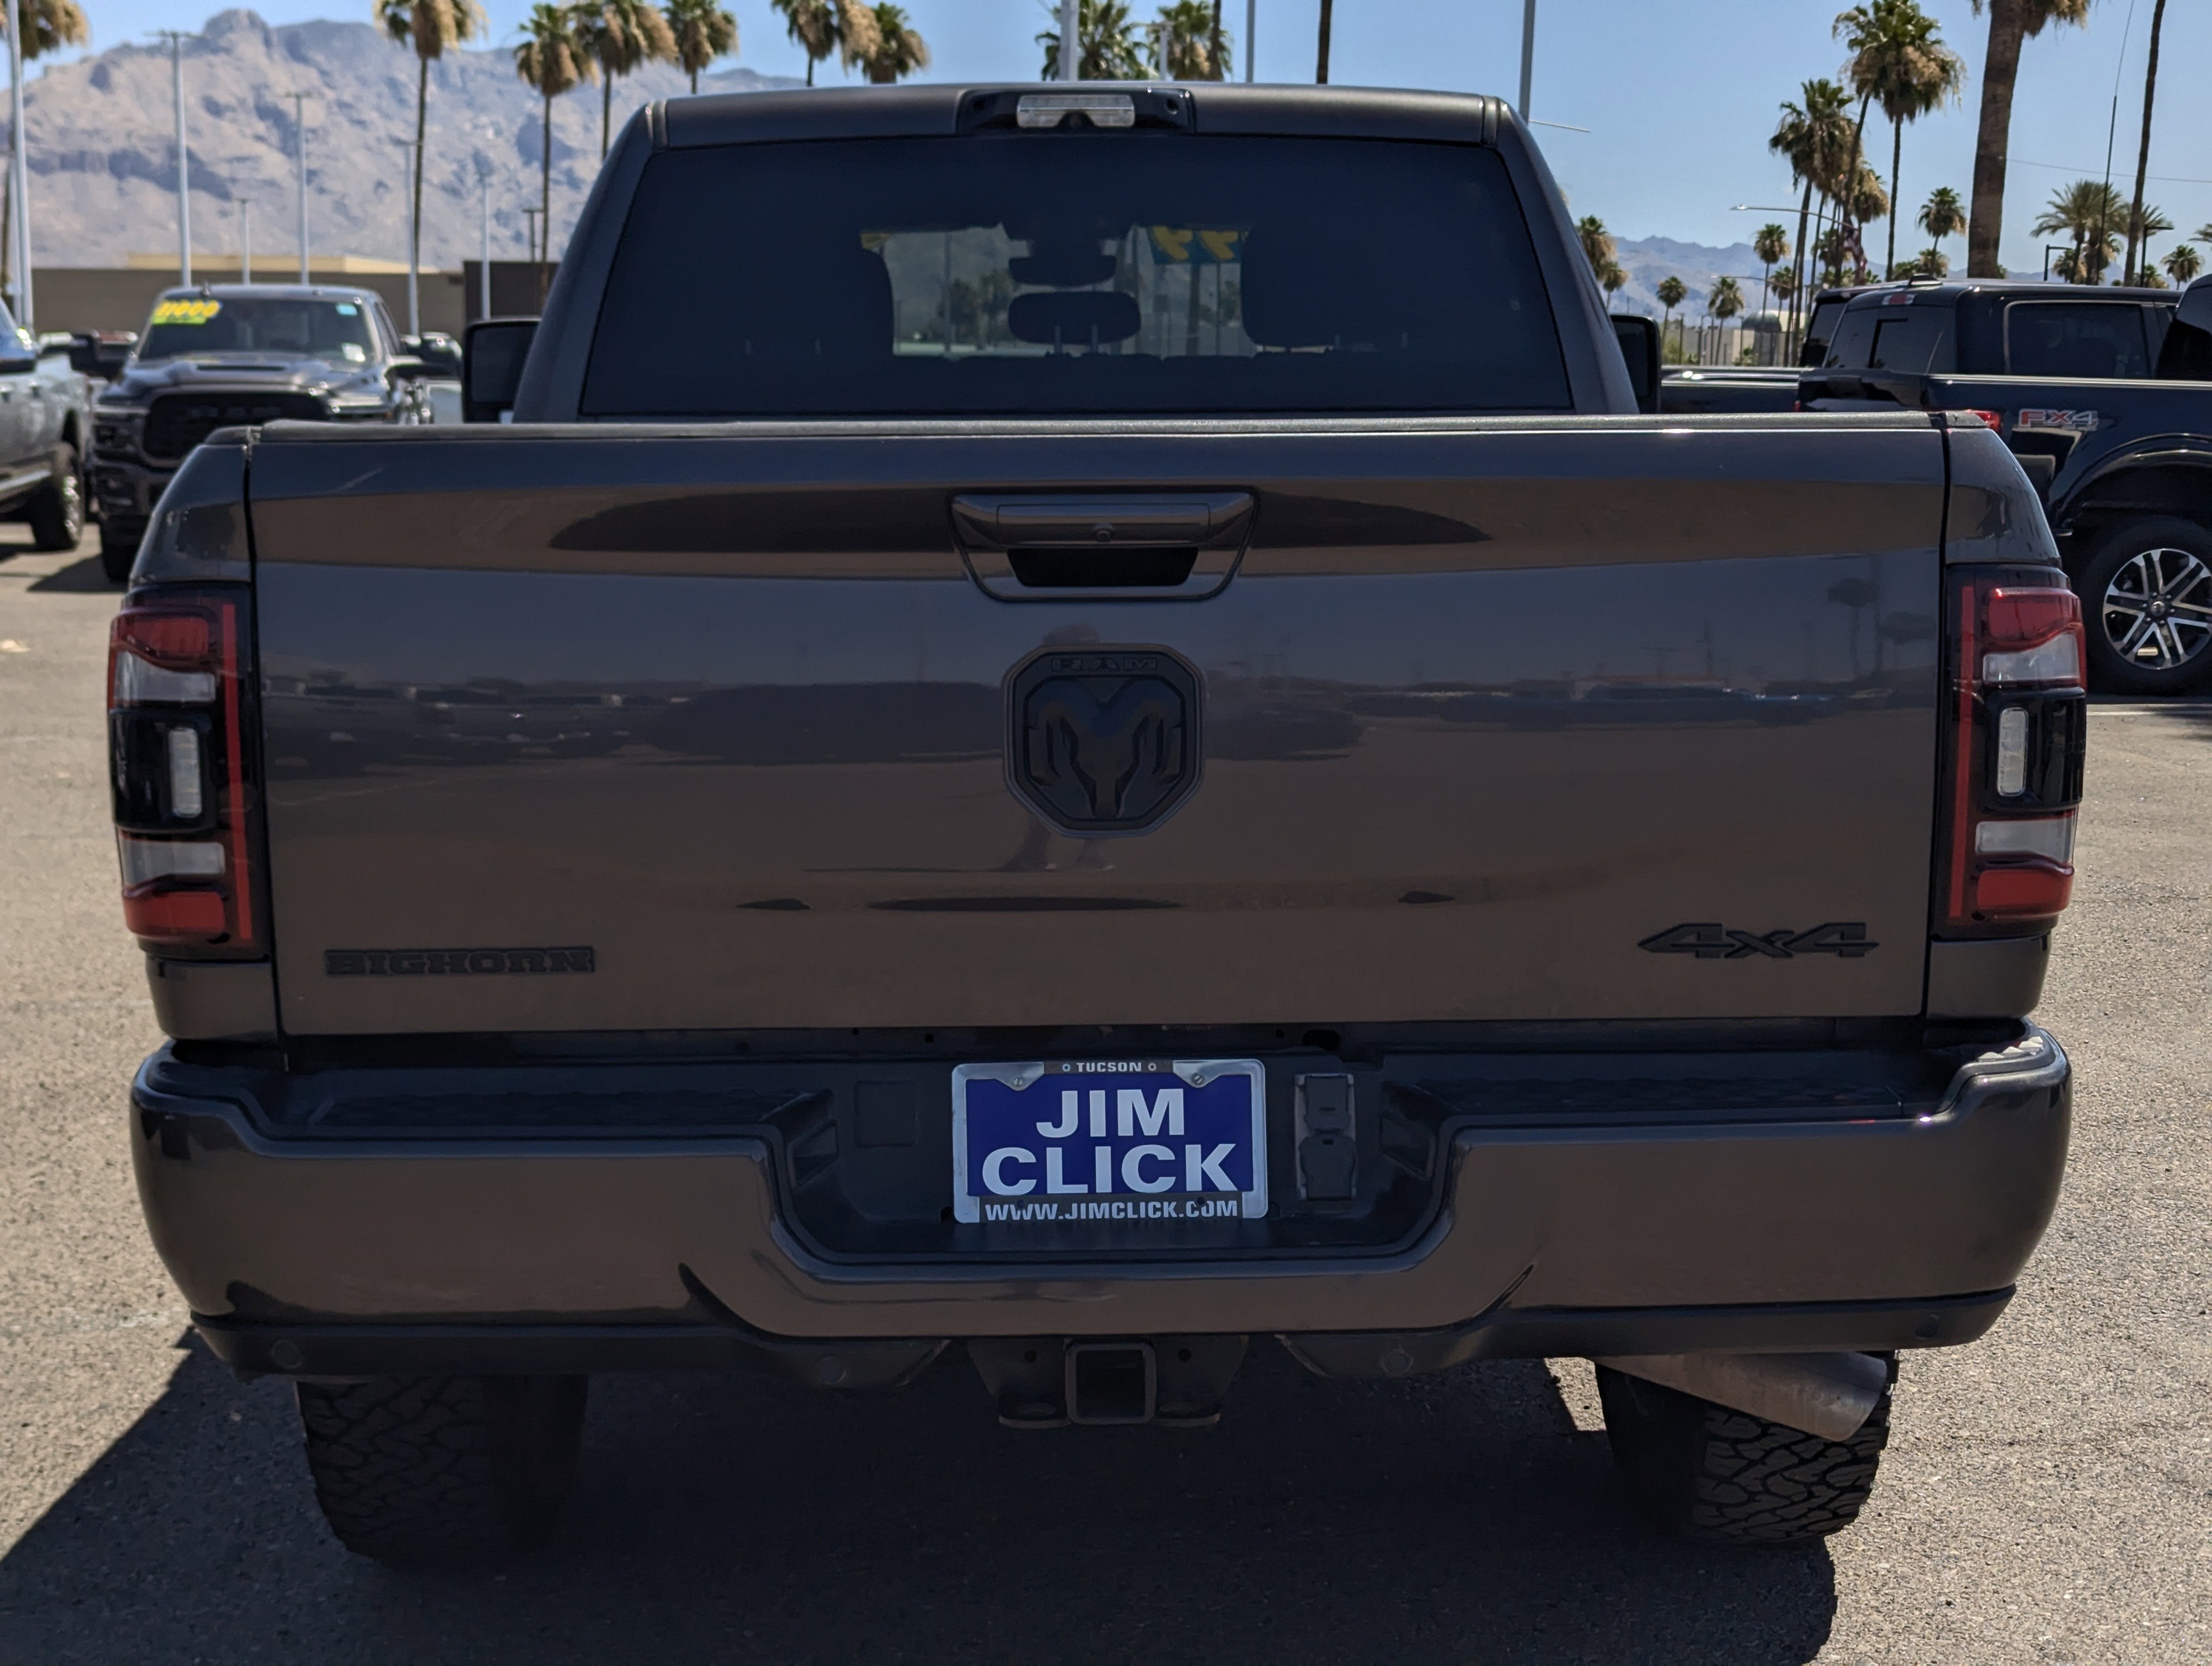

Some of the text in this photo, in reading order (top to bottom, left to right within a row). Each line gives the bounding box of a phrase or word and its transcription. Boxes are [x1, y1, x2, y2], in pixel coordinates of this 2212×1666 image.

[2019, 408, 2098, 428] FX4
[1051, 658, 1158, 672] RAM
[325, 947, 595, 975] BIGHORN
[1076, 1061, 1142, 1072] TUCSON
[1036, 1088, 1185, 1138] JIM
[982, 1143, 1238, 1195] CLICK
[985, 1200, 1237, 1221] WWW.JIMCLICK.COM
